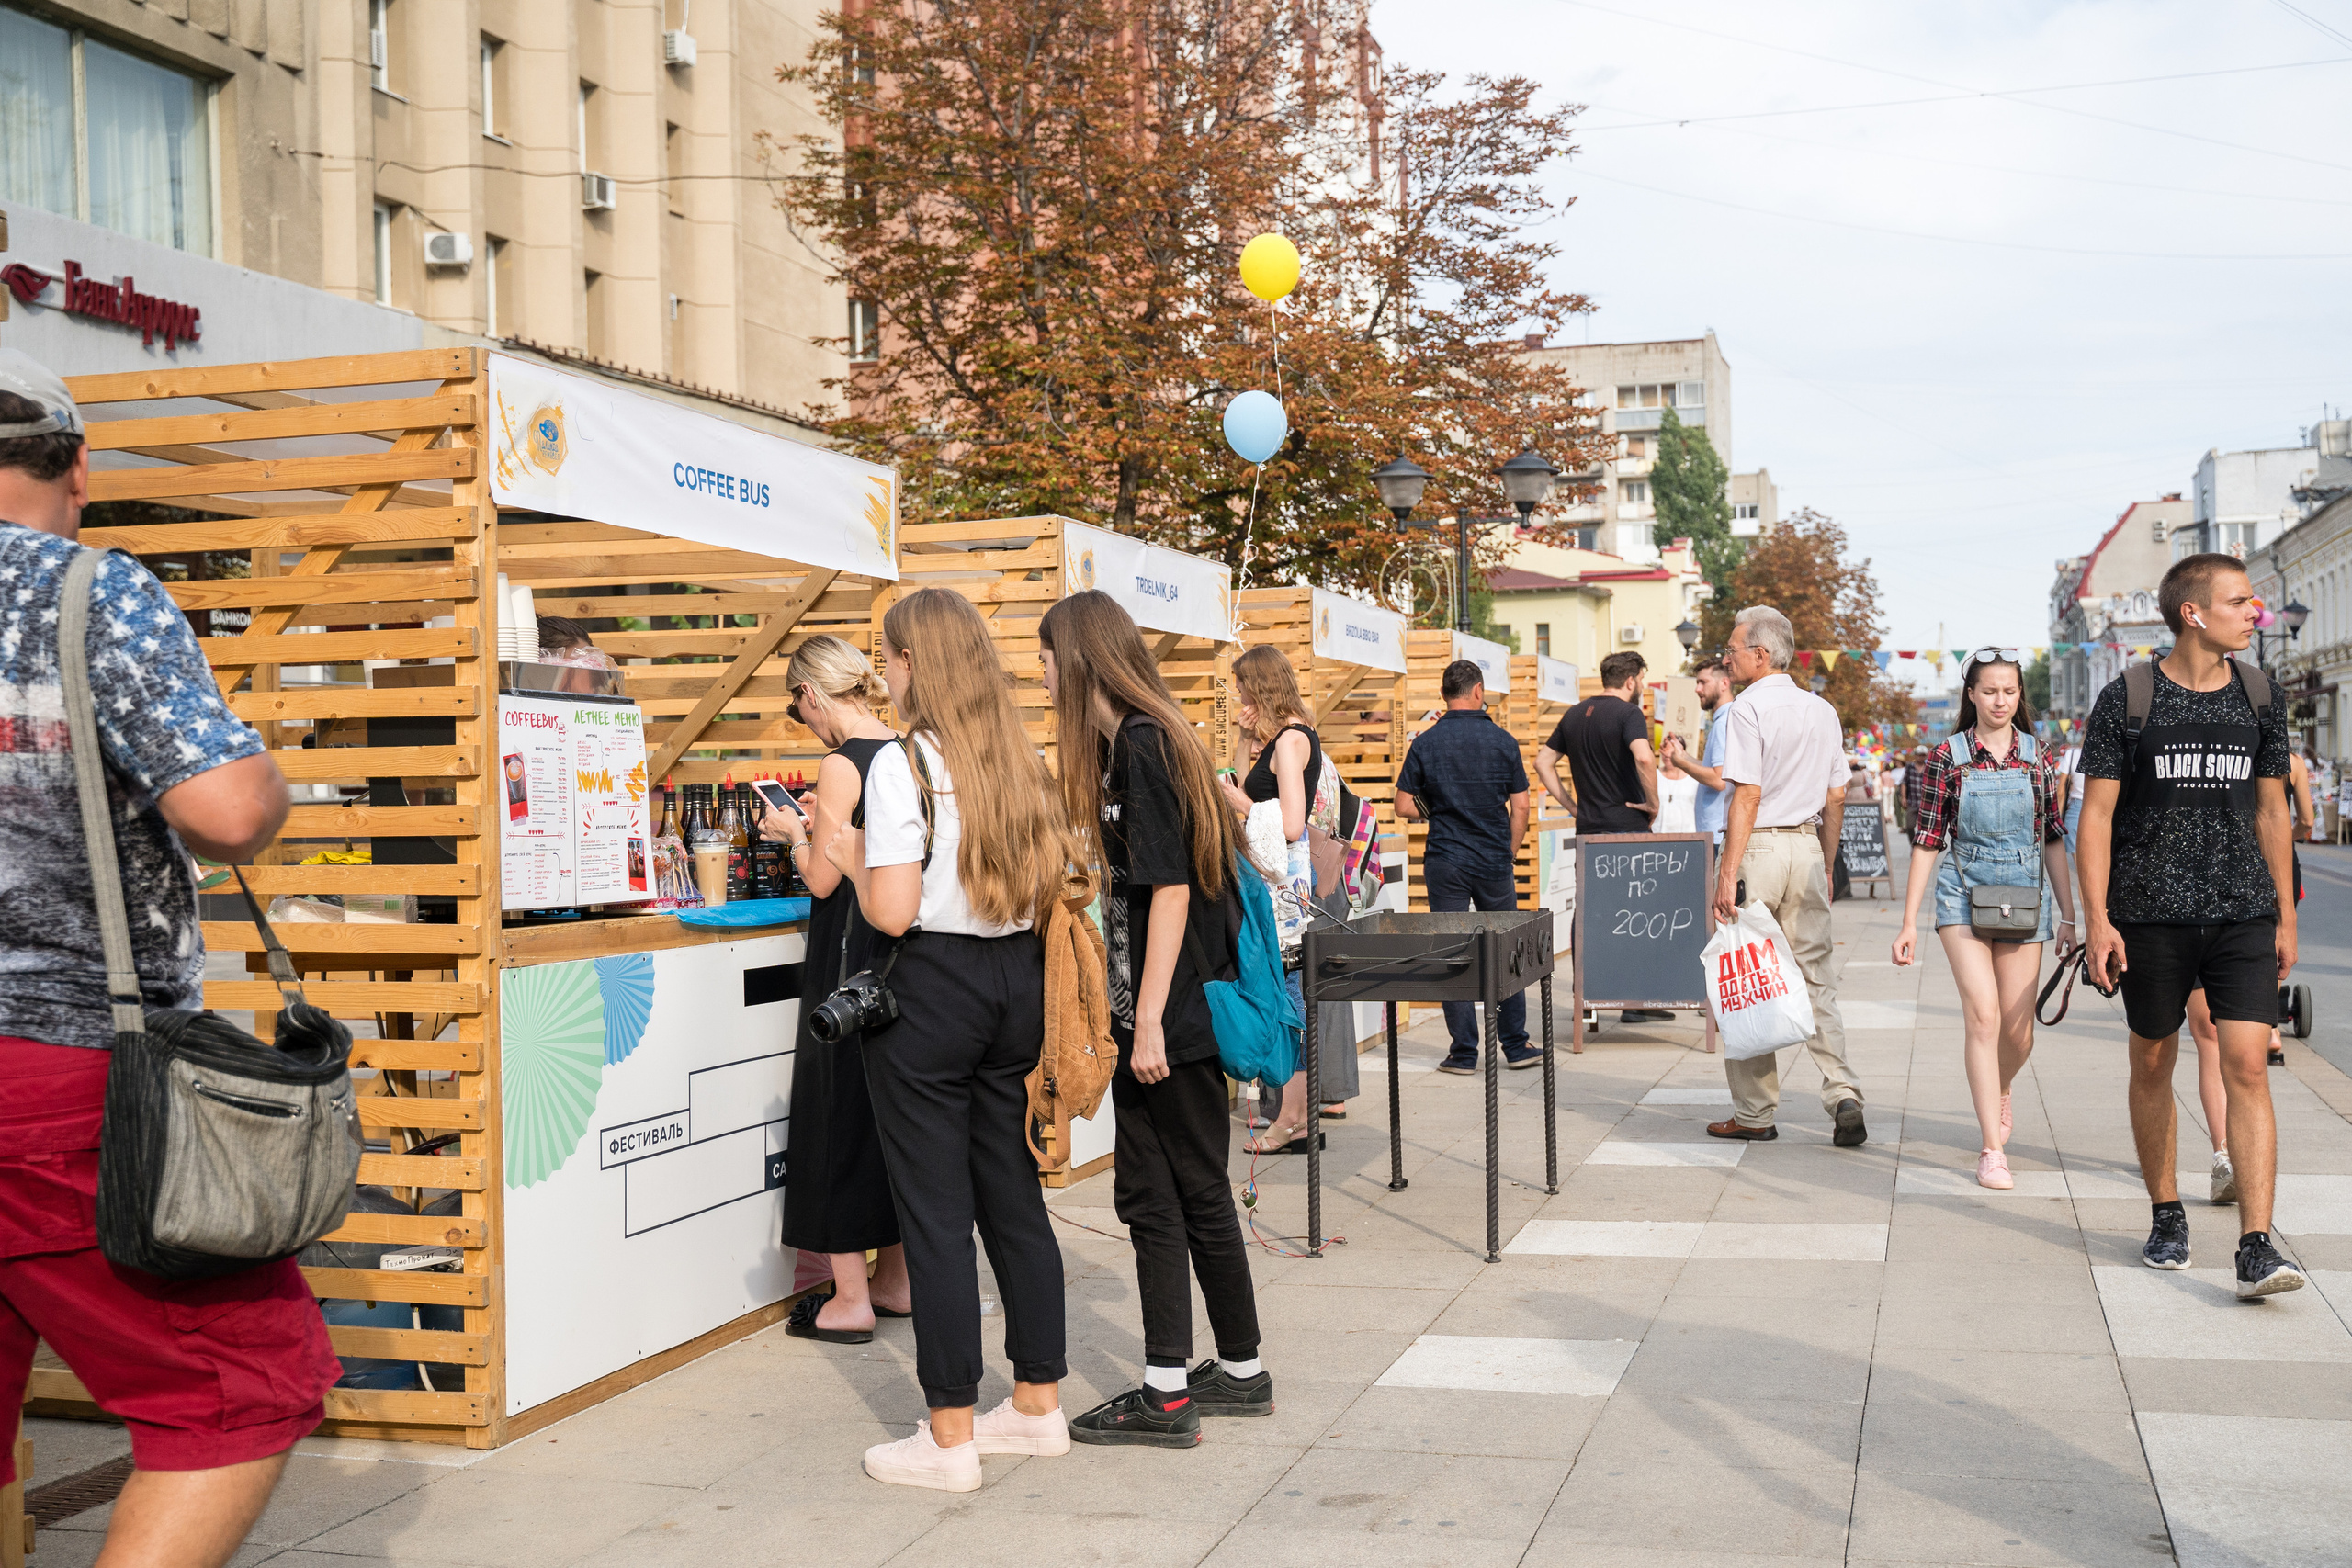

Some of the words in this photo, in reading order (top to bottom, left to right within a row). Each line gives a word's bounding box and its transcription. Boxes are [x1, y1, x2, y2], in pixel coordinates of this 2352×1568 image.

[673, 462, 735, 501] COFFEE
[739, 477, 770, 509] BUS
[1135, 575, 1179, 603] TRDELNIK_64
[504, 710, 560, 729] COFFEEBUS
[574, 709, 611, 726] ЛЕТНЕЕ
[614, 711, 640, 727] МЕНЮ
[2154, 753, 2202, 779] BLACK
[2205, 753, 2252, 781] SQVAD
[1594, 850, 1690, 879] БУРГЕРЫ
[1627, 878, 1657, 898] ПО
[1720, 981, 1789, 1015] МУЖЧИН
[608, 1122, 684, 1156] ФЕСТИВАЛЬ
[772, 1161, 787, 1179] СА
